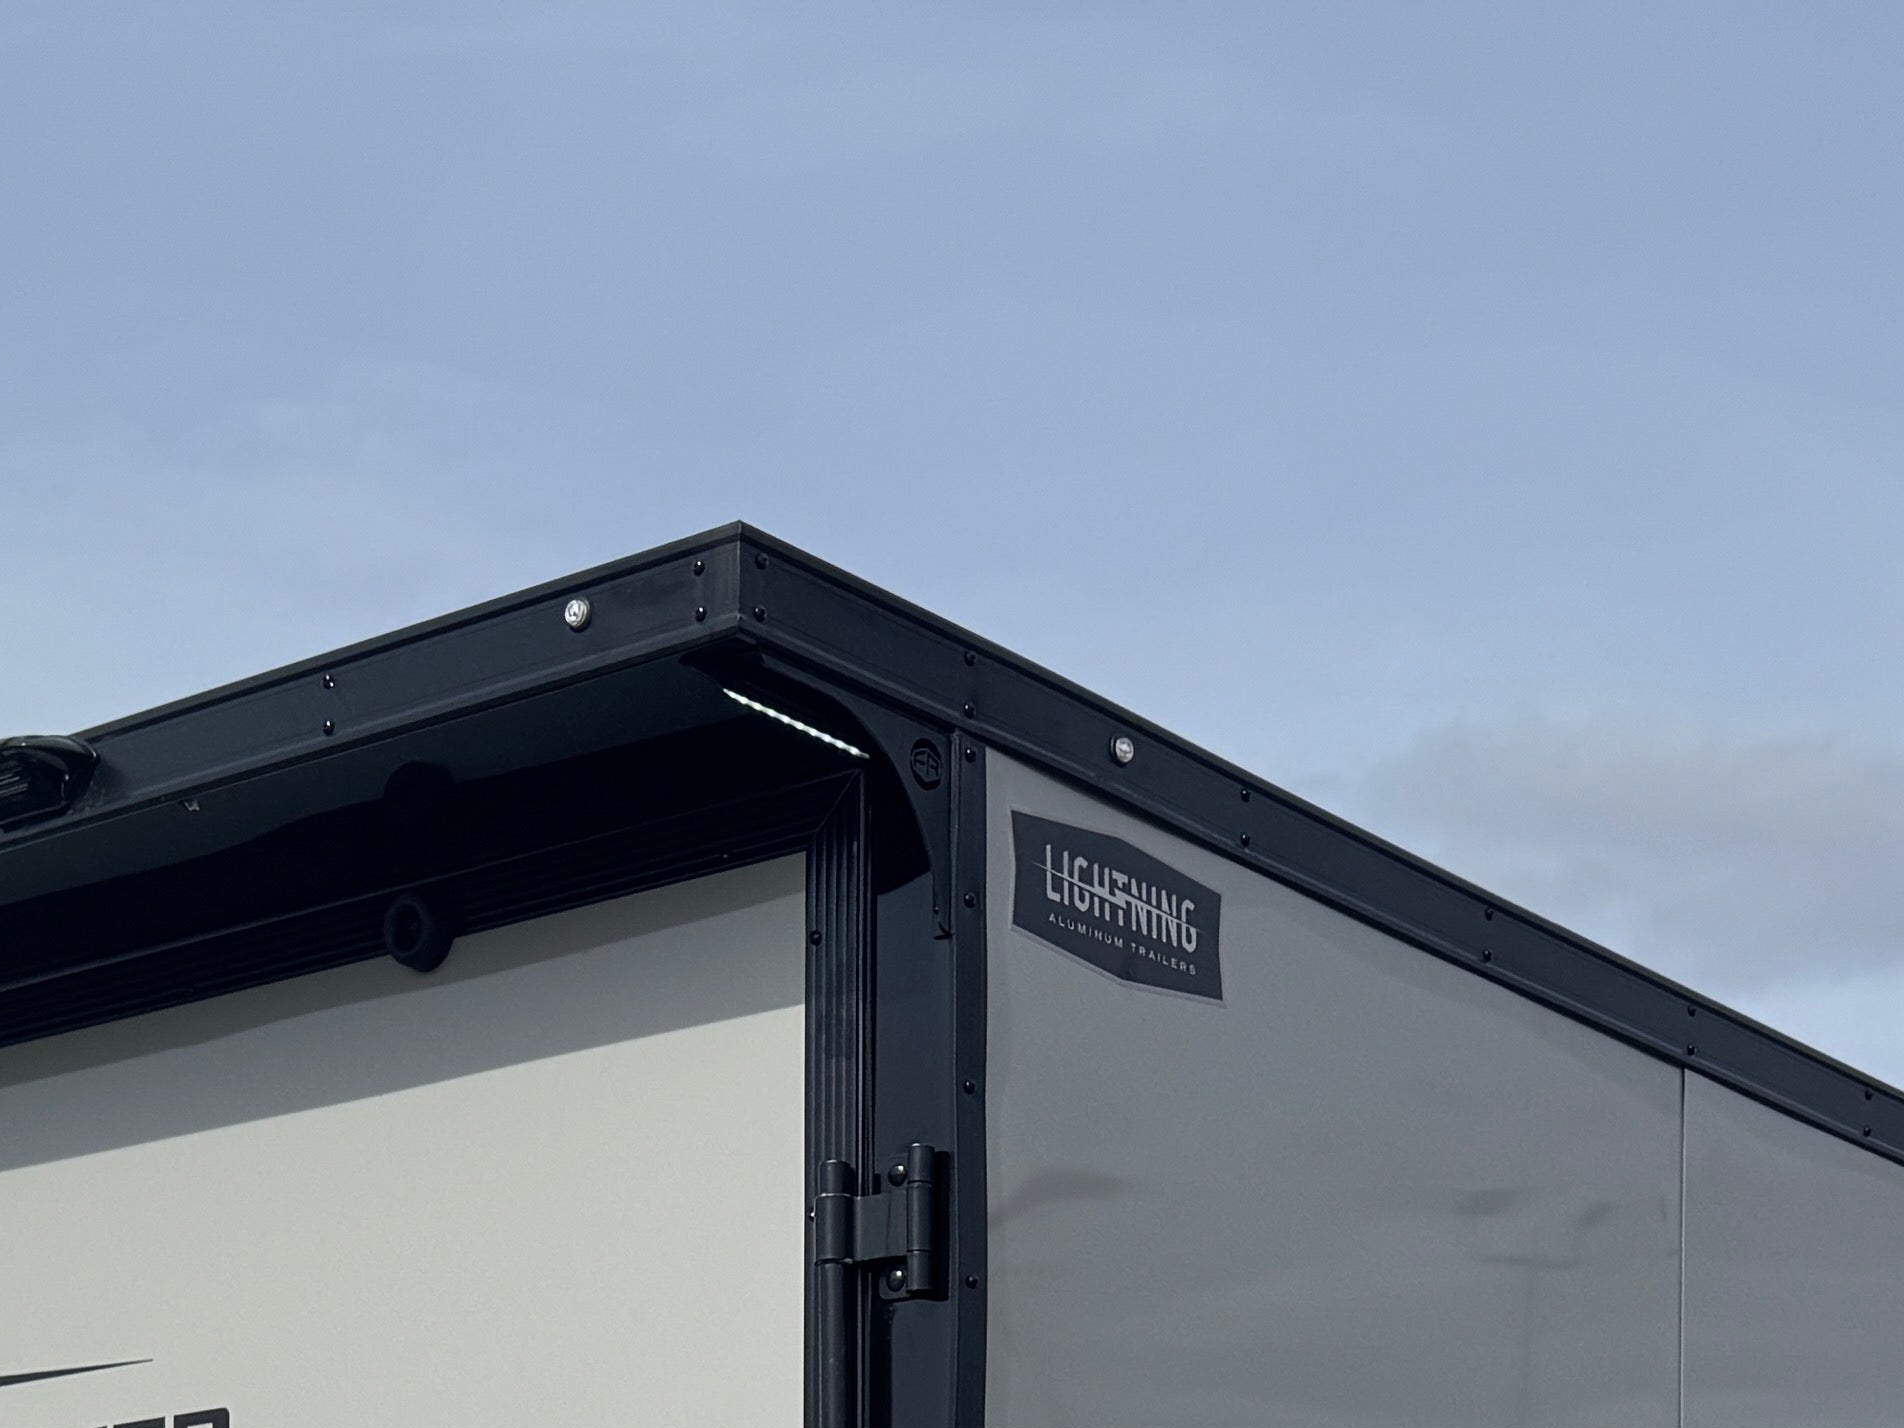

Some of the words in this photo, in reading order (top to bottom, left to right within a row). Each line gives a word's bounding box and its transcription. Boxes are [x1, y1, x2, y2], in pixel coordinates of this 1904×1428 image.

[1046, 844, 1196, 953] LIGHTNING
[1049, 912, 1123, 948] ALUMINUM
[1131, 942, 1196, 975] TRAILERS
